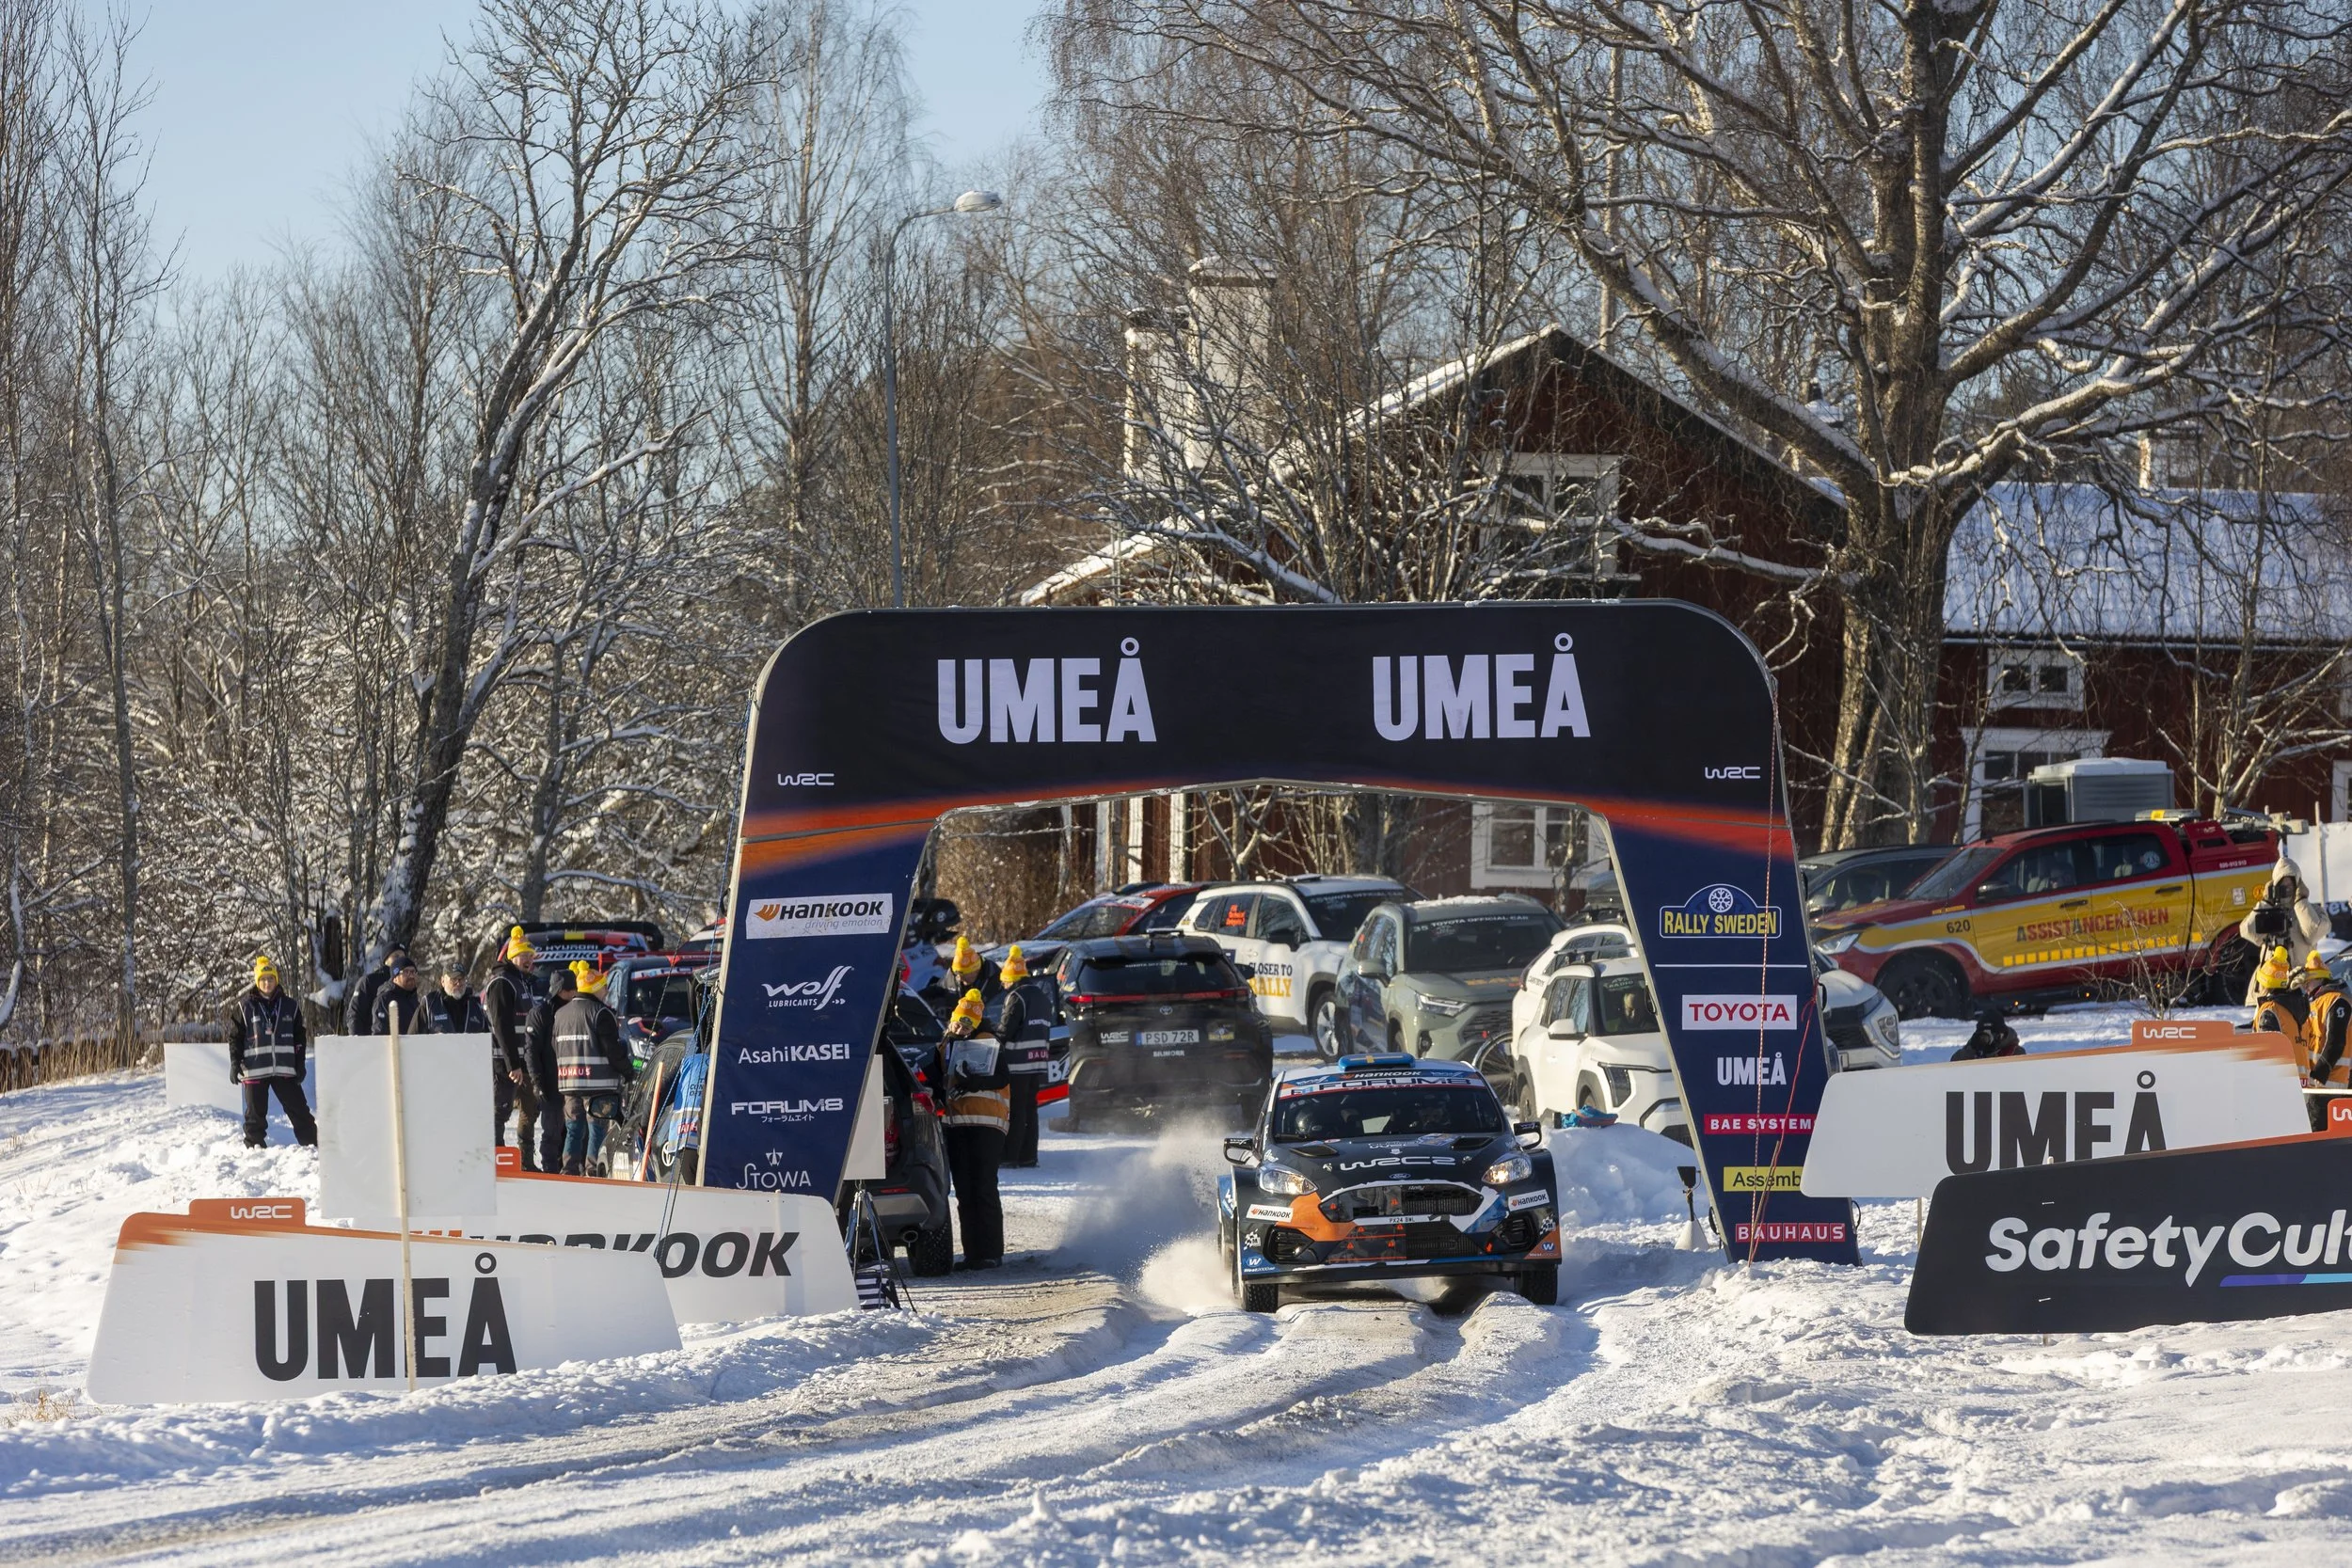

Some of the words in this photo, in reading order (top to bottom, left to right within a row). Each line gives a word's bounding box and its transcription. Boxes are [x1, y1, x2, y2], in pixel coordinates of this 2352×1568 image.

[938, 637, 1157, 744] UMEÅ
[1373, 632, 1591, 741] UMEÅ
[777, 772, 834, 786] WRC
[1705, 766, 1761, 780] WRC
[805, 919, 839, 930] driving
[842, 918, 882, 927] emotion
[1664, 911, 1709, 934] RALLY
[1714, 911, 1776, 934] SWEDEN
[1946, 919, 1971, 934] 620
[1281, 964, 1293, 976] TO
[769, 998, 818, 1008] LUBRICANTS
[1689, 1003, 1789, 1022] TOYOTA
[1145, 1032, 1168, 1043] PSD
[1171, 1031, 1195, 1042] 72R
[2142, 1026, 2196, 1038] WRC
[739, 1043, 850, 1065] AsahiKASEI
[1717, 1053, 1787, 1085] UMEÅ
[731, 1098, 844, 1115] FORUM8
[761, 1115, 815, 1123] フォーラムエイト
[1710, 1118, 1741, 1130] BAE
[1747, 1117, 1817, 1130] SYSTEM
[1946, 1070, 2167, 1175] UMEÅ
[1340, 1156, 1456, 1171] WRC2
[230, 1206, 293, 1219] WRC
[1738, 1226, 1843, 1240] BAUHAUS
[254, 1252, 516, 1381] UMEÅ
